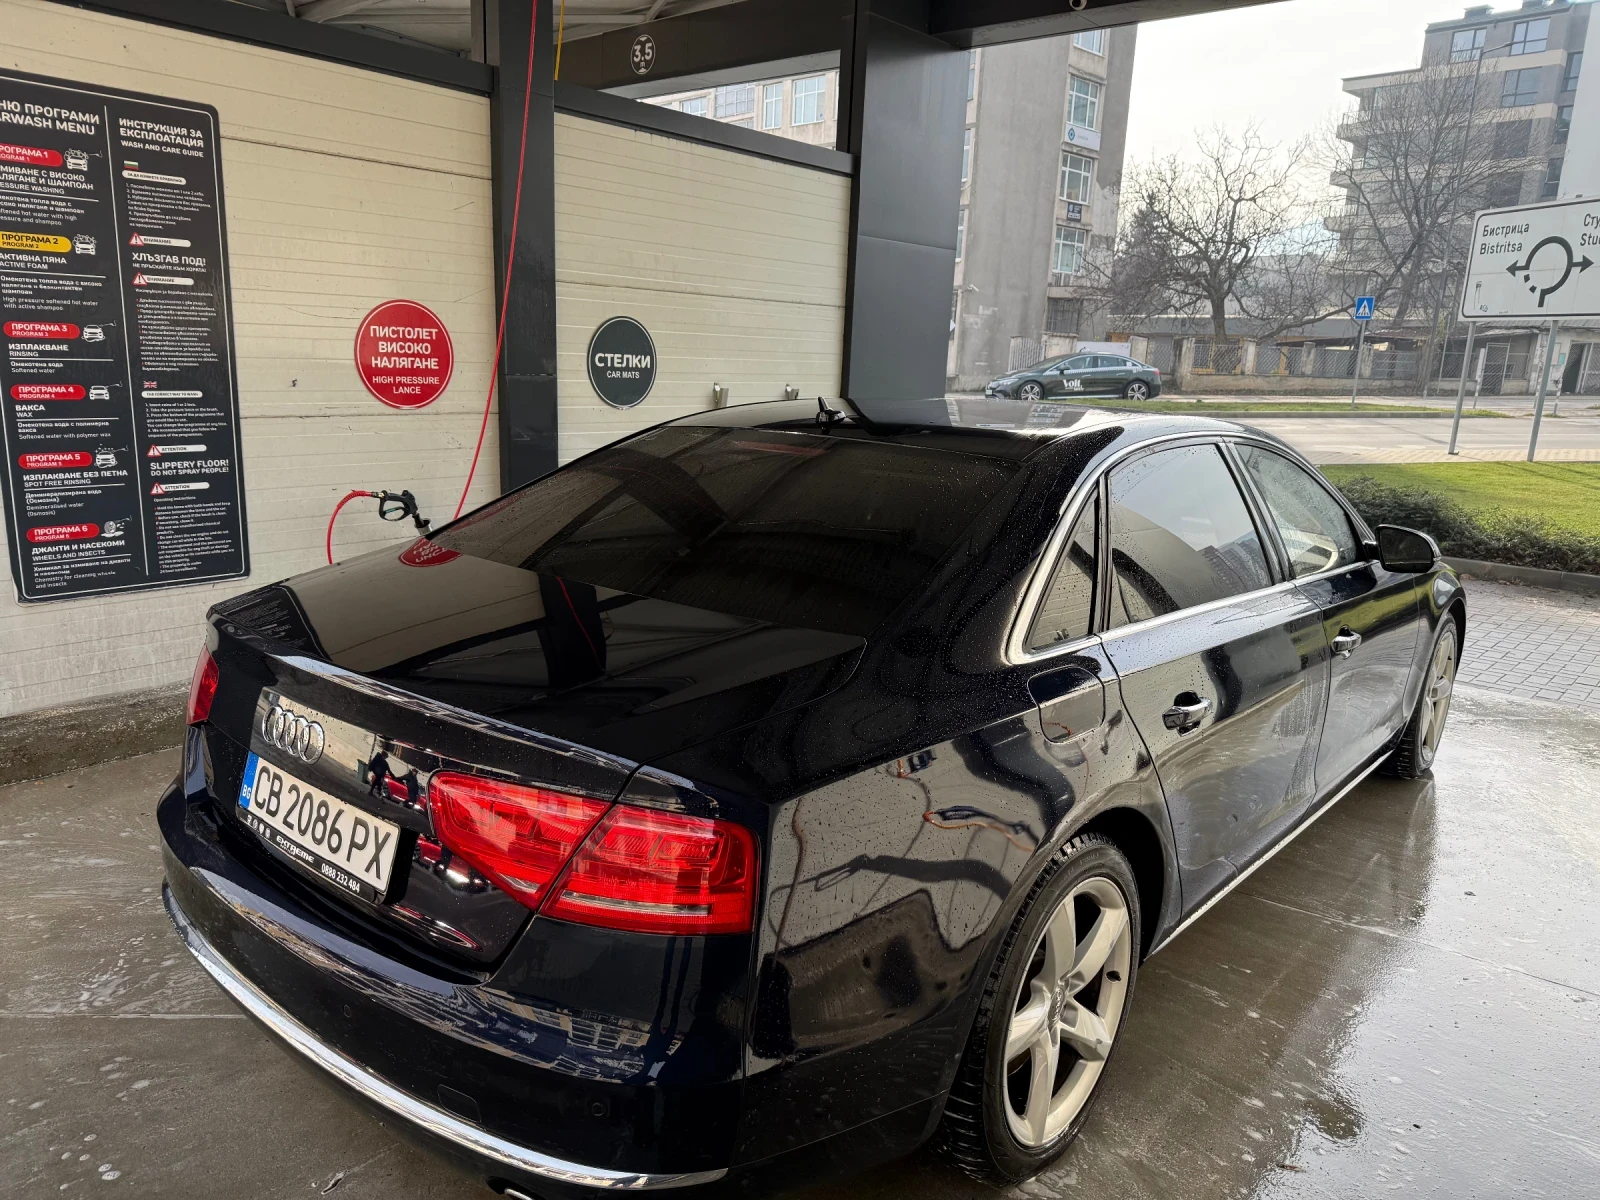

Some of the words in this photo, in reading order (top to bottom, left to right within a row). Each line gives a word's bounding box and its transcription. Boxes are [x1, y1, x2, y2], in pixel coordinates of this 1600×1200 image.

[24, 103, 100, 124] ПРОГРАМИ
[0, 112, 52, 128] RWASH
[56, 120, 95, 135] MENU
[119, 118, 187, 136] ИНСТРУКЦИЯ
[189, 129, 203, 138] ЗА
[120, 128, 204, 148] ЕКСПЛОАТАЦИЯ
[121, 140, 144, 149] WASH
[162, 146, 181, 154] CARE
[182, 148, 204, 158] GUIDE
[0, 165, 39, 176] МИВАНЕ
[50, 171, 84, 182] ВИСОКО
[0, 172, 37, 184] ЛЯГАНЕ
[48, 179, 94, 190] ШАМПОАН
[32, 185, 65, 194] WASHING
[1583, 213, 1600, 229] Сту
[1482, 223, 1530, 238] Бистрица
[1, 233, 51, 244] ПРОГРАМА
[1580, 233, 1600, 246] Stu
[1480, 241, 1523, 255] Bistritsa
[0, 252, 41, 262] АКТИВНА
[42, 256, 67, 264] ПЯНА
[132, 252, 179, 264] ХЛЪЗГАВ
[181, 256, 207, 267] ПОД!
[11, 323, 60, 332] ПРОГРАМА
[370, 326, 438, 340] ПИСТОЛЕТ
[378, 341, 431, 354] ВИСОКО
[371, 356, 439, 369] НАЛЯГАНЕ
[594, 353, 650, 368] СТЕЛКИ
[396, 376, 440, 384] PRESSURE
[26, 454, 73, 462] ПРОГРАМА
[150, 460, 195, 470] SLIPPERY
[197, 459, 229, 467] FLOOR!
[23, 472, 82, 481] ИЗПЛАКВАНЕ
[34, 527, 80, 536] ПРОГРАМА
[32, 545, 70, 555] ДЖАНТИ
[80, 540, 125, 550] НАСЕКОМИ
[242, 784, 251, 799] BG
[254, 765, 283, 818] CB
[282, 783, 344, 854] 2086
[346, 816, 391, 881] PX
[321, 863, 336, 879] 0888
[336, 871, 348, 886] 232
[348, 879, 360, 893] 484
